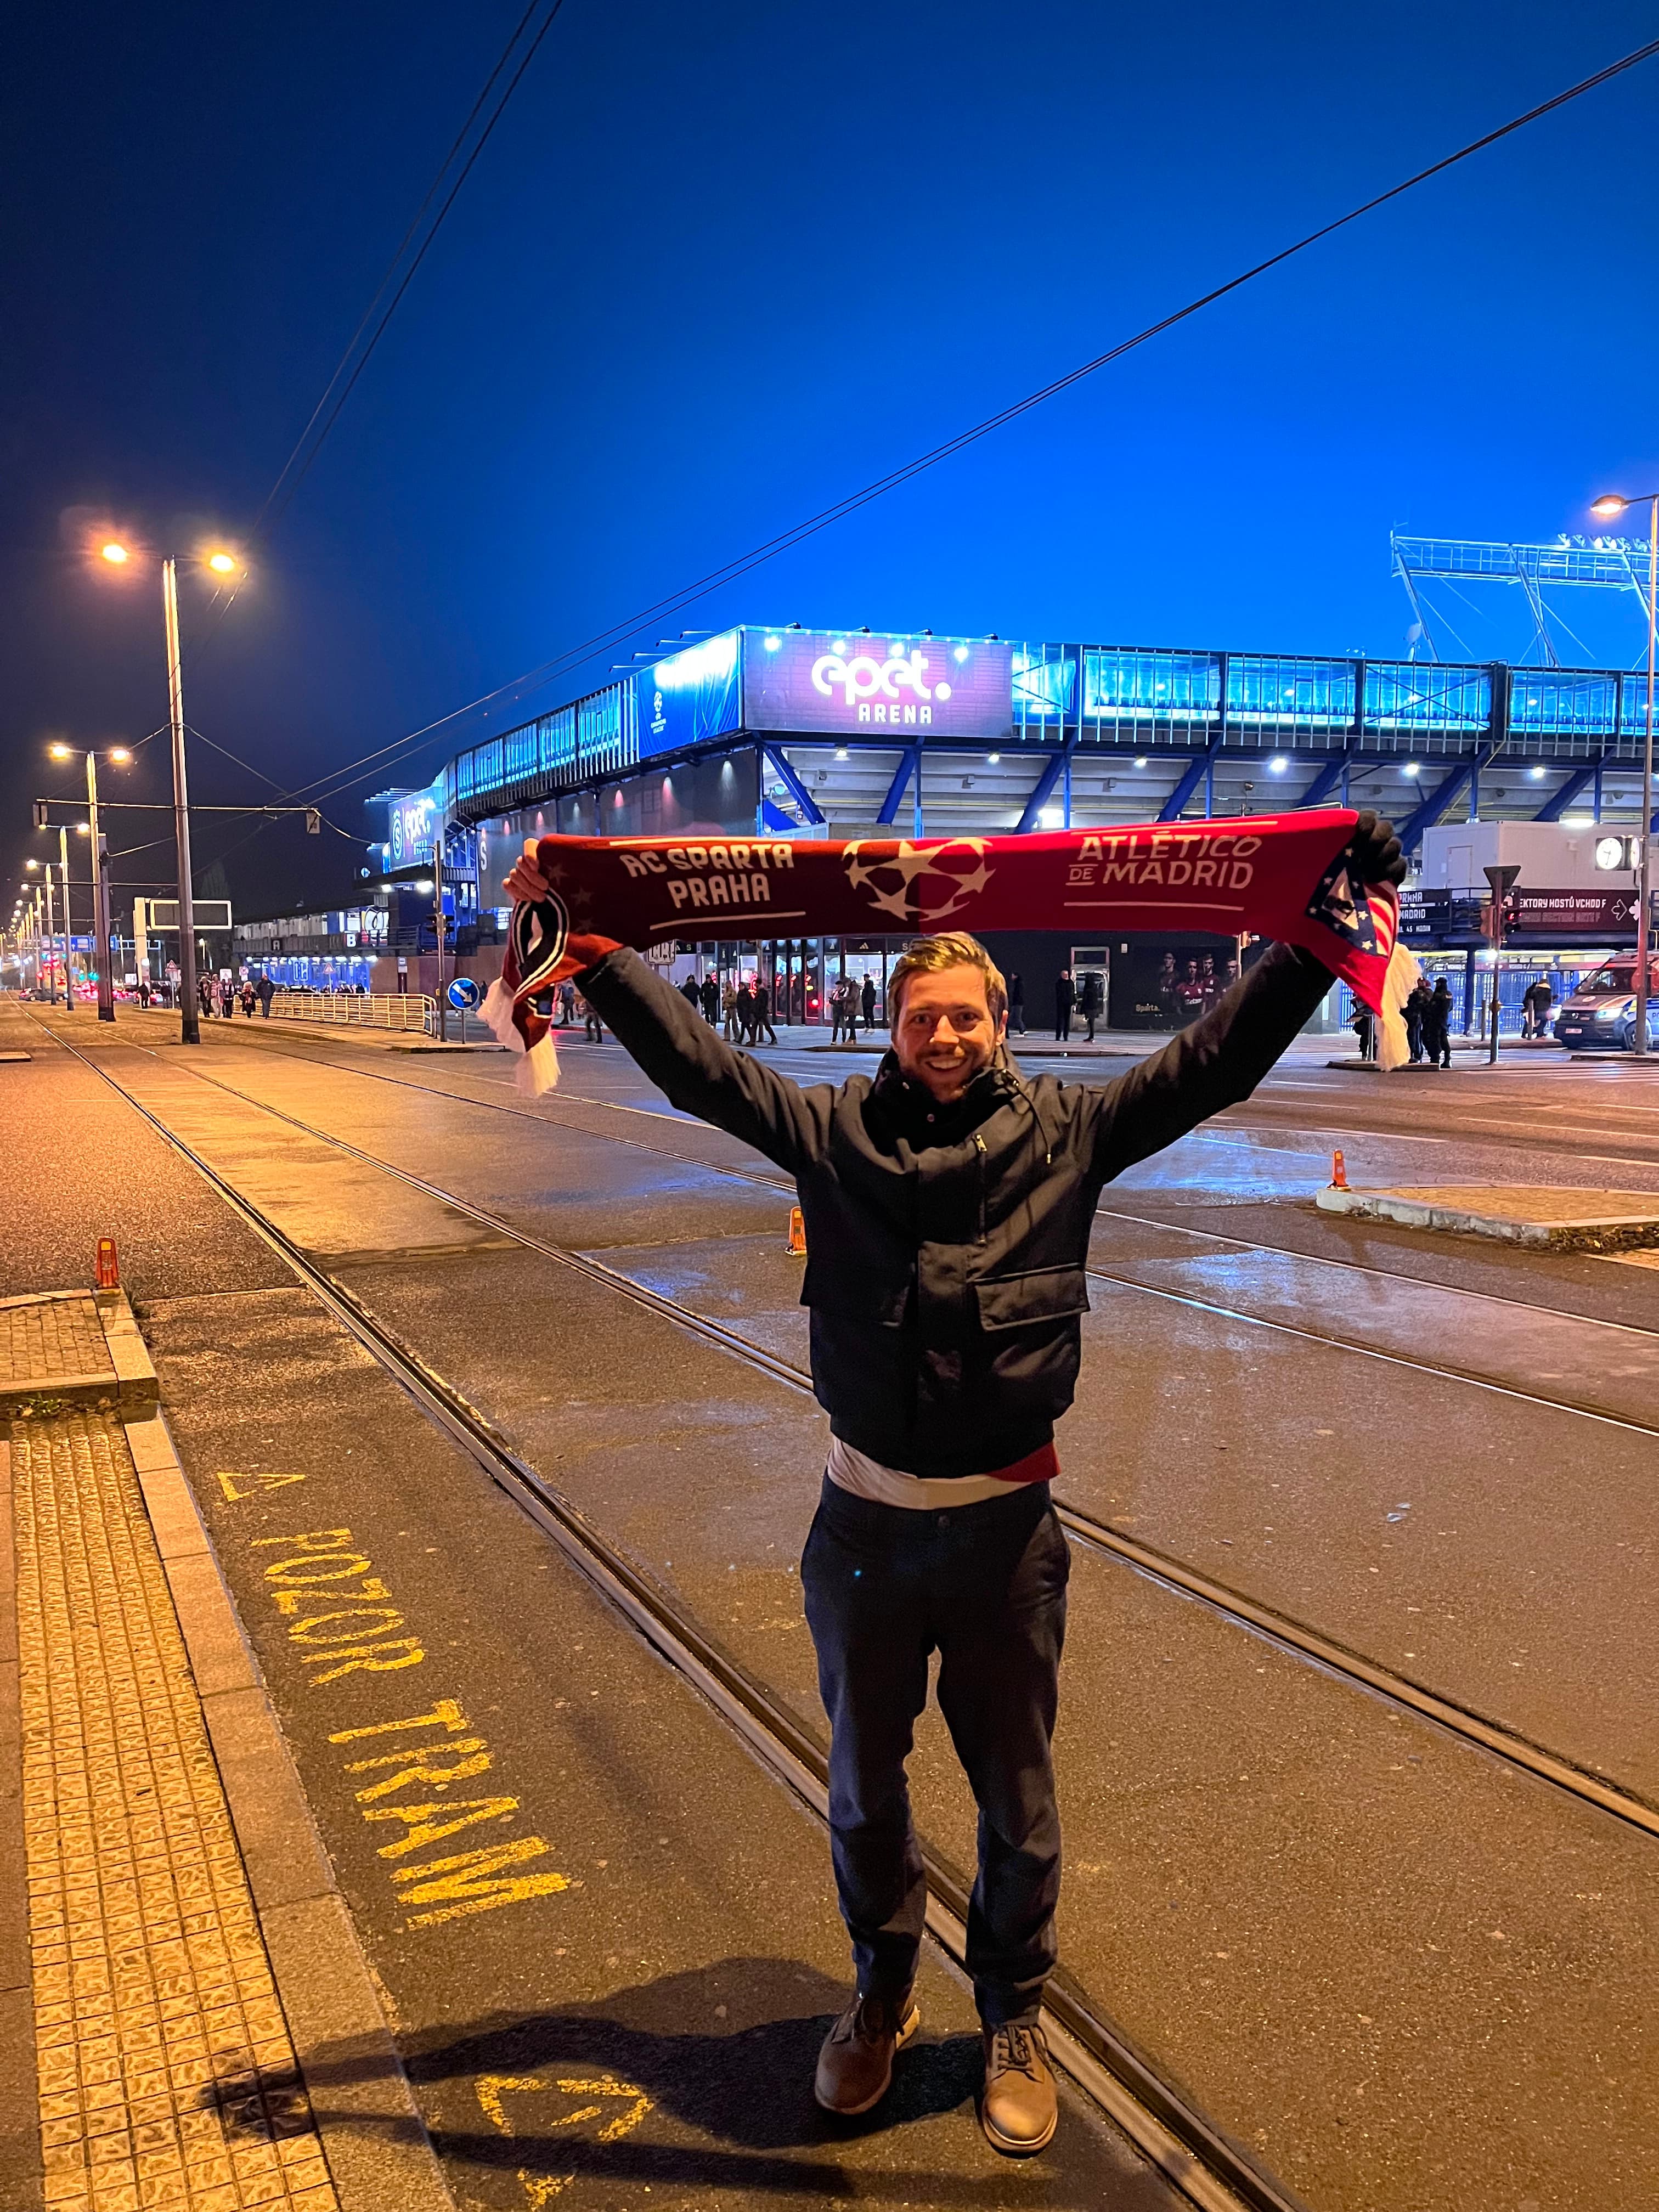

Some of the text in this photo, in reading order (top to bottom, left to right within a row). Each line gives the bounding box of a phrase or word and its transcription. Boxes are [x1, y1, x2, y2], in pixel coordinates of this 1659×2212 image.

[858, 703, 932, 724] ARENA
[619, 843, 794, 878] AC SPARTA
[1077, 830, 1262, 861] ATLÉTICO
[1070, 860, 1254, 889] DE MADRID
[667, 873, 771, 909] PRAHA
[1576, 899, 1600, 908] VCHOD
[346, 934, 356, 947] B
[250, 1528, 572, 1930] POZOR TRAM
